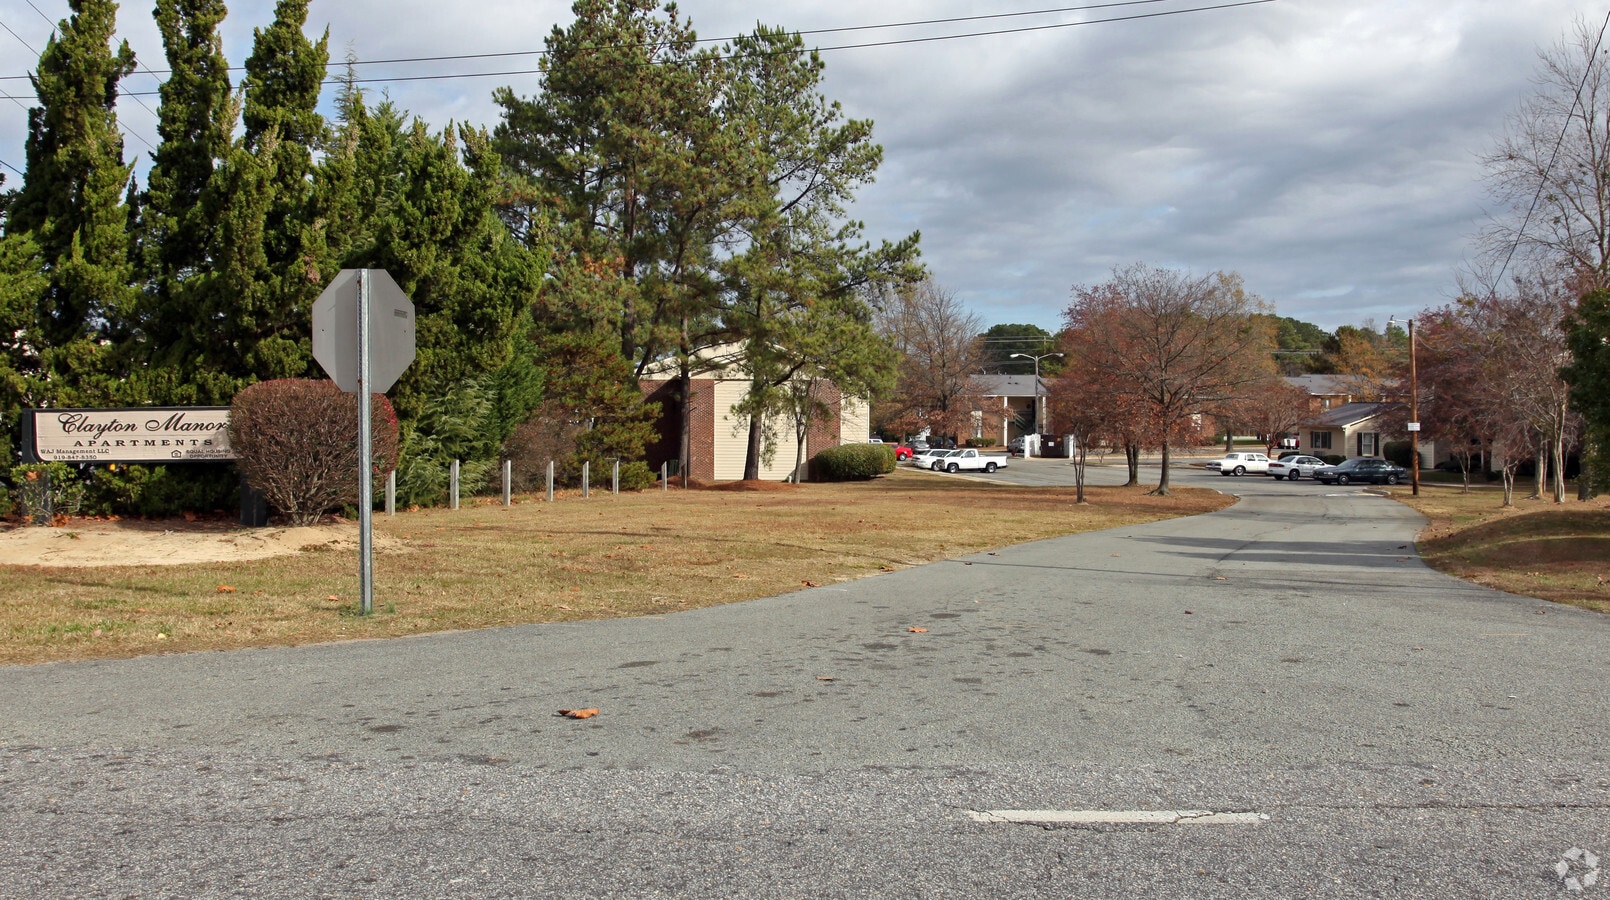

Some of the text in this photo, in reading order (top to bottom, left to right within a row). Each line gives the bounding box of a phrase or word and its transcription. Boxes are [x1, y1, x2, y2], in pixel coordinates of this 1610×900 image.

[58, 412, 228, 440] Clayton Manor
[74, 439, 213, 447] APARTMENTS
